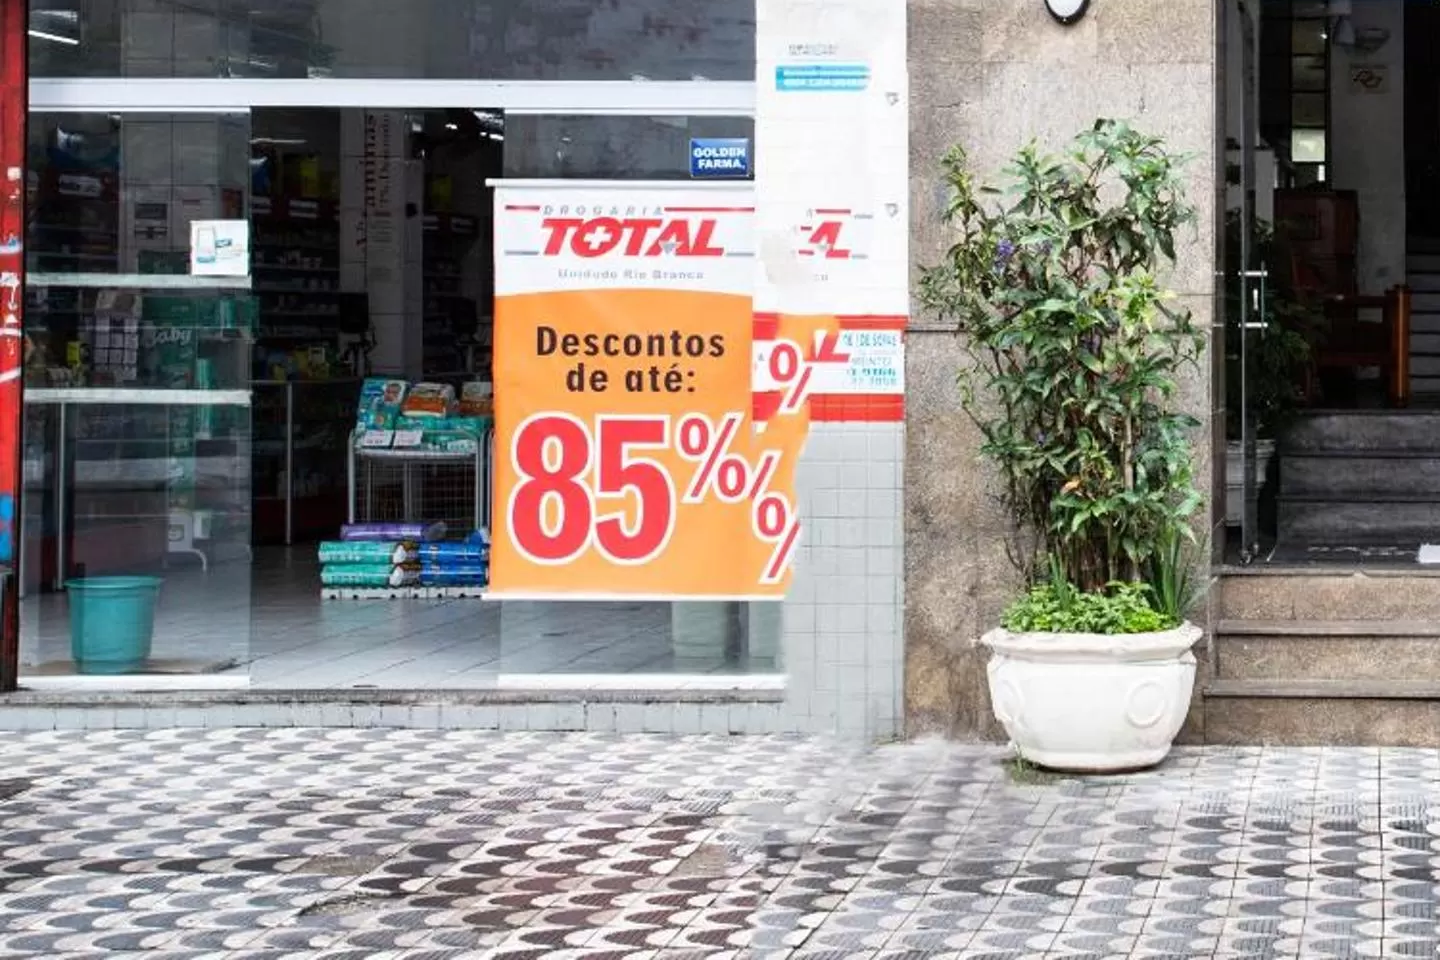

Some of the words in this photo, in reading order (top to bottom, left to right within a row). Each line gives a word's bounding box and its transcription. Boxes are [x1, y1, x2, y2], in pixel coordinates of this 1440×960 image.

[693, 147, 746, 158] GOLDEN
[543, 204, 664, 215] DROGARIA
[541, 216, 724, 258] TOTAL
[536, 326, 726, 357] Descontos
[565, 363, 609, 393] de
[624, 363, 696, 393] até:
[509, 416, 747, 561] 85%
